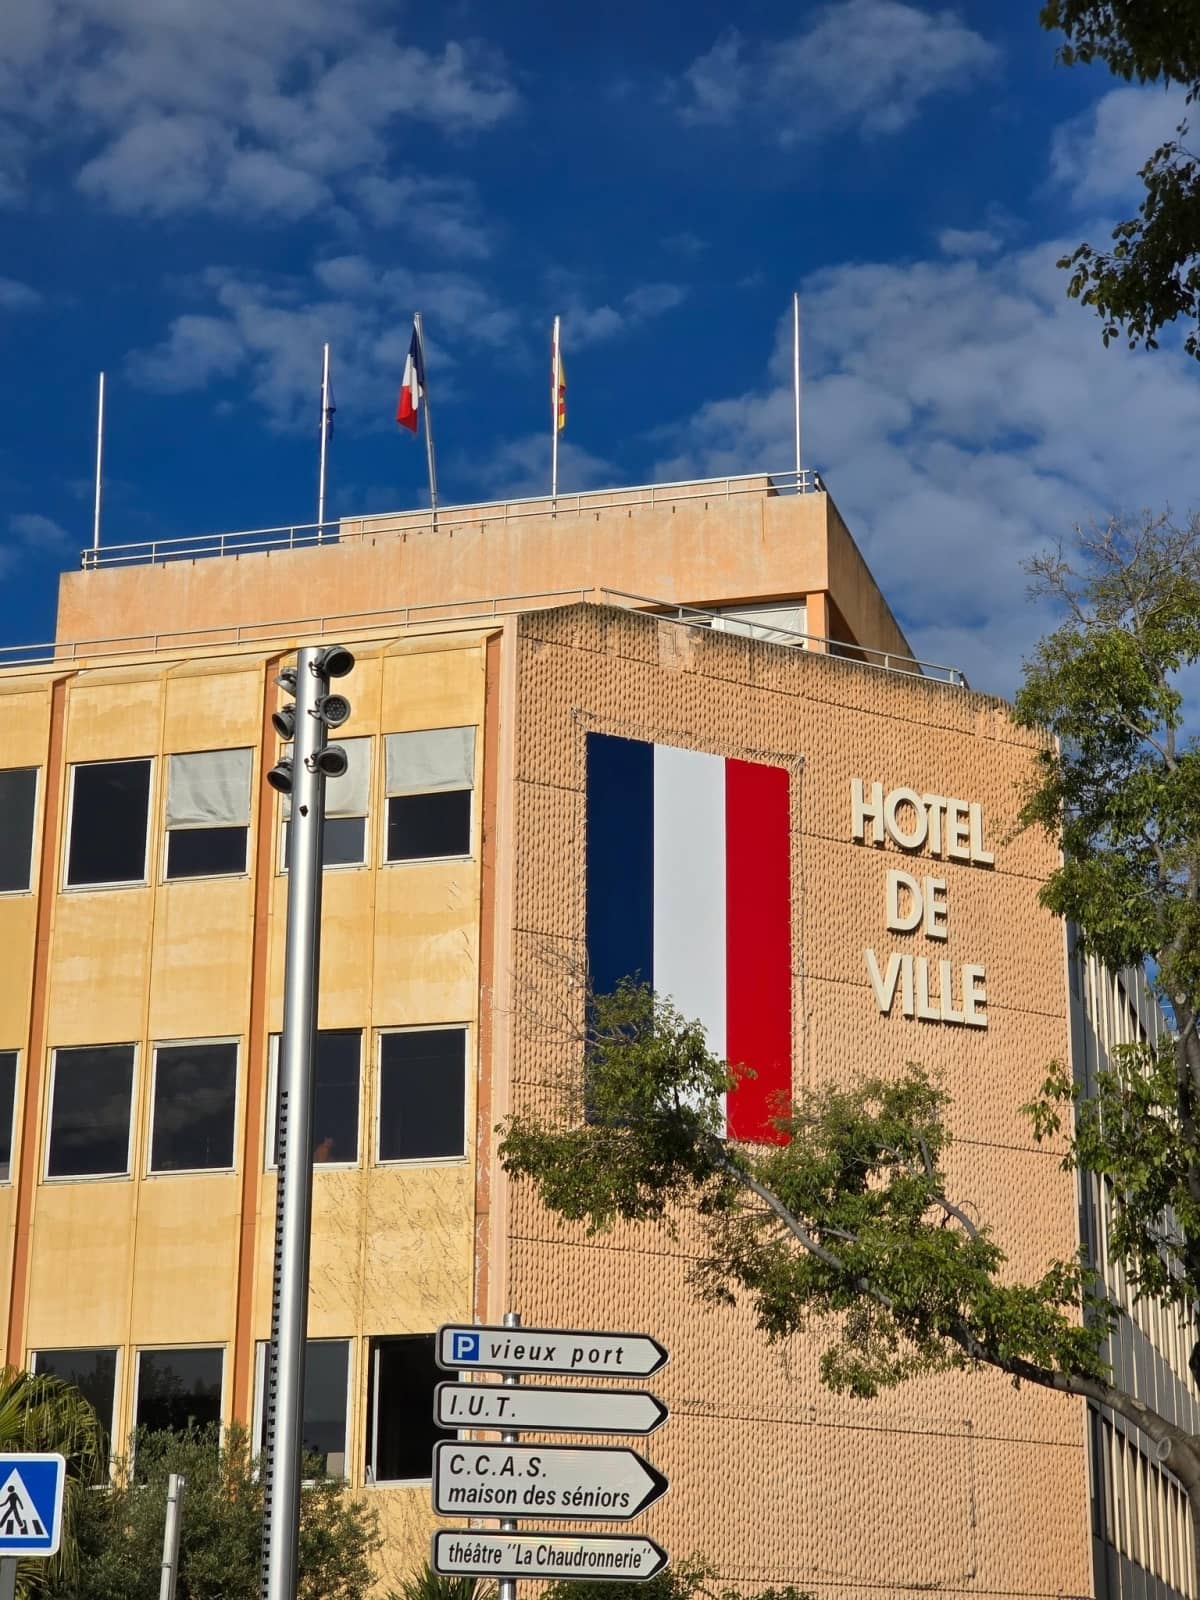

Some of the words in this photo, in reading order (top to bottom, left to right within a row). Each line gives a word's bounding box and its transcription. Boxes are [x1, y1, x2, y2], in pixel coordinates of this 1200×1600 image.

[851, 777, 994, 865] HOTEL
[887, 868, 948, 939] DE
[865, 948, 988, 1027] VILLE
[457, 1336, 475, 1360] P
[490, 1340, 556, 1362] vieux
[571, 1346, 624, 1368] port
[450, 1394, 516, 1417] I.U.T.
[449, 1454, 547, 1478] C.C.A.S.
[448, 1483, 517, 1505] maison
[523, 1485, 556, 1506] des
[561, 1486, 630, 1508] séniors
[448, 1542, 502, 1565] théâtre
